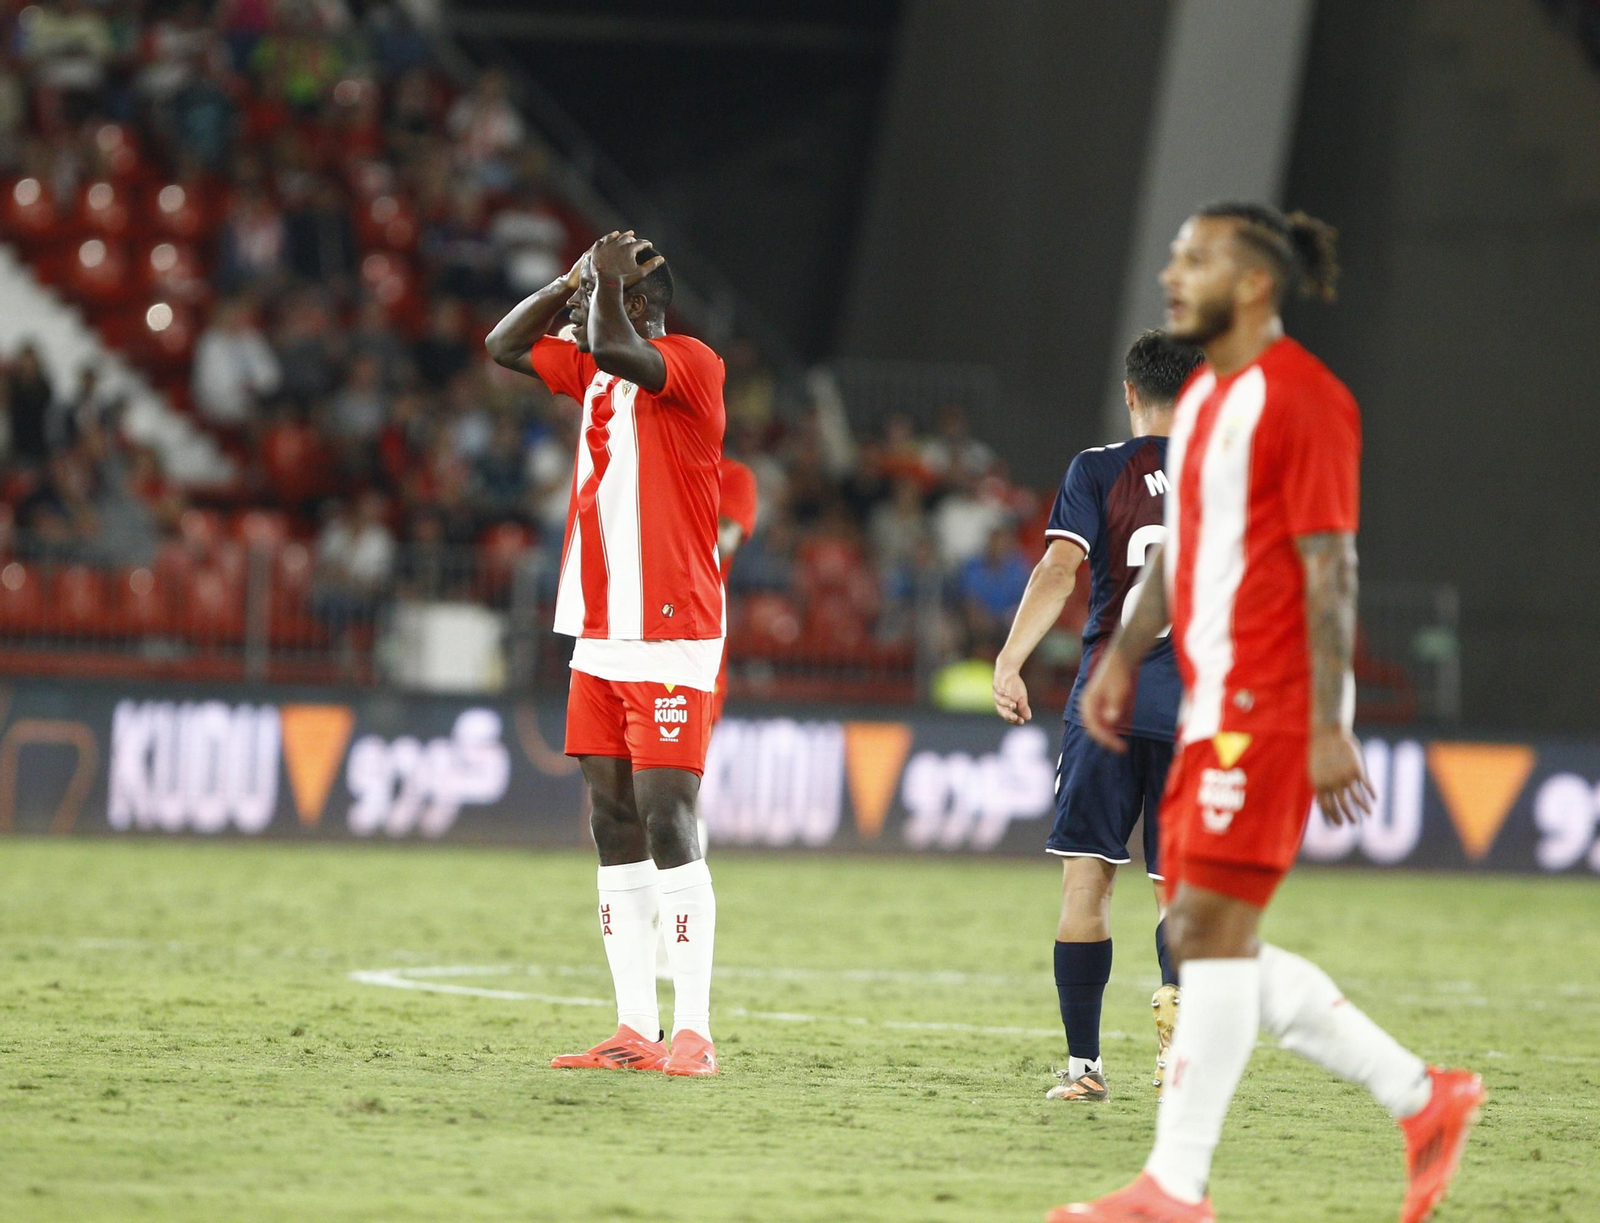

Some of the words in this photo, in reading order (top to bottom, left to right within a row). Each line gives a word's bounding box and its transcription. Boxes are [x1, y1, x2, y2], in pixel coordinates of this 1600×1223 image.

[1144, 469, 1171, 497] M
[654, 708, 688, 724] KUDU
[600, 903, 613, 936] UDA
[676, 914, 690, 943] UDA
